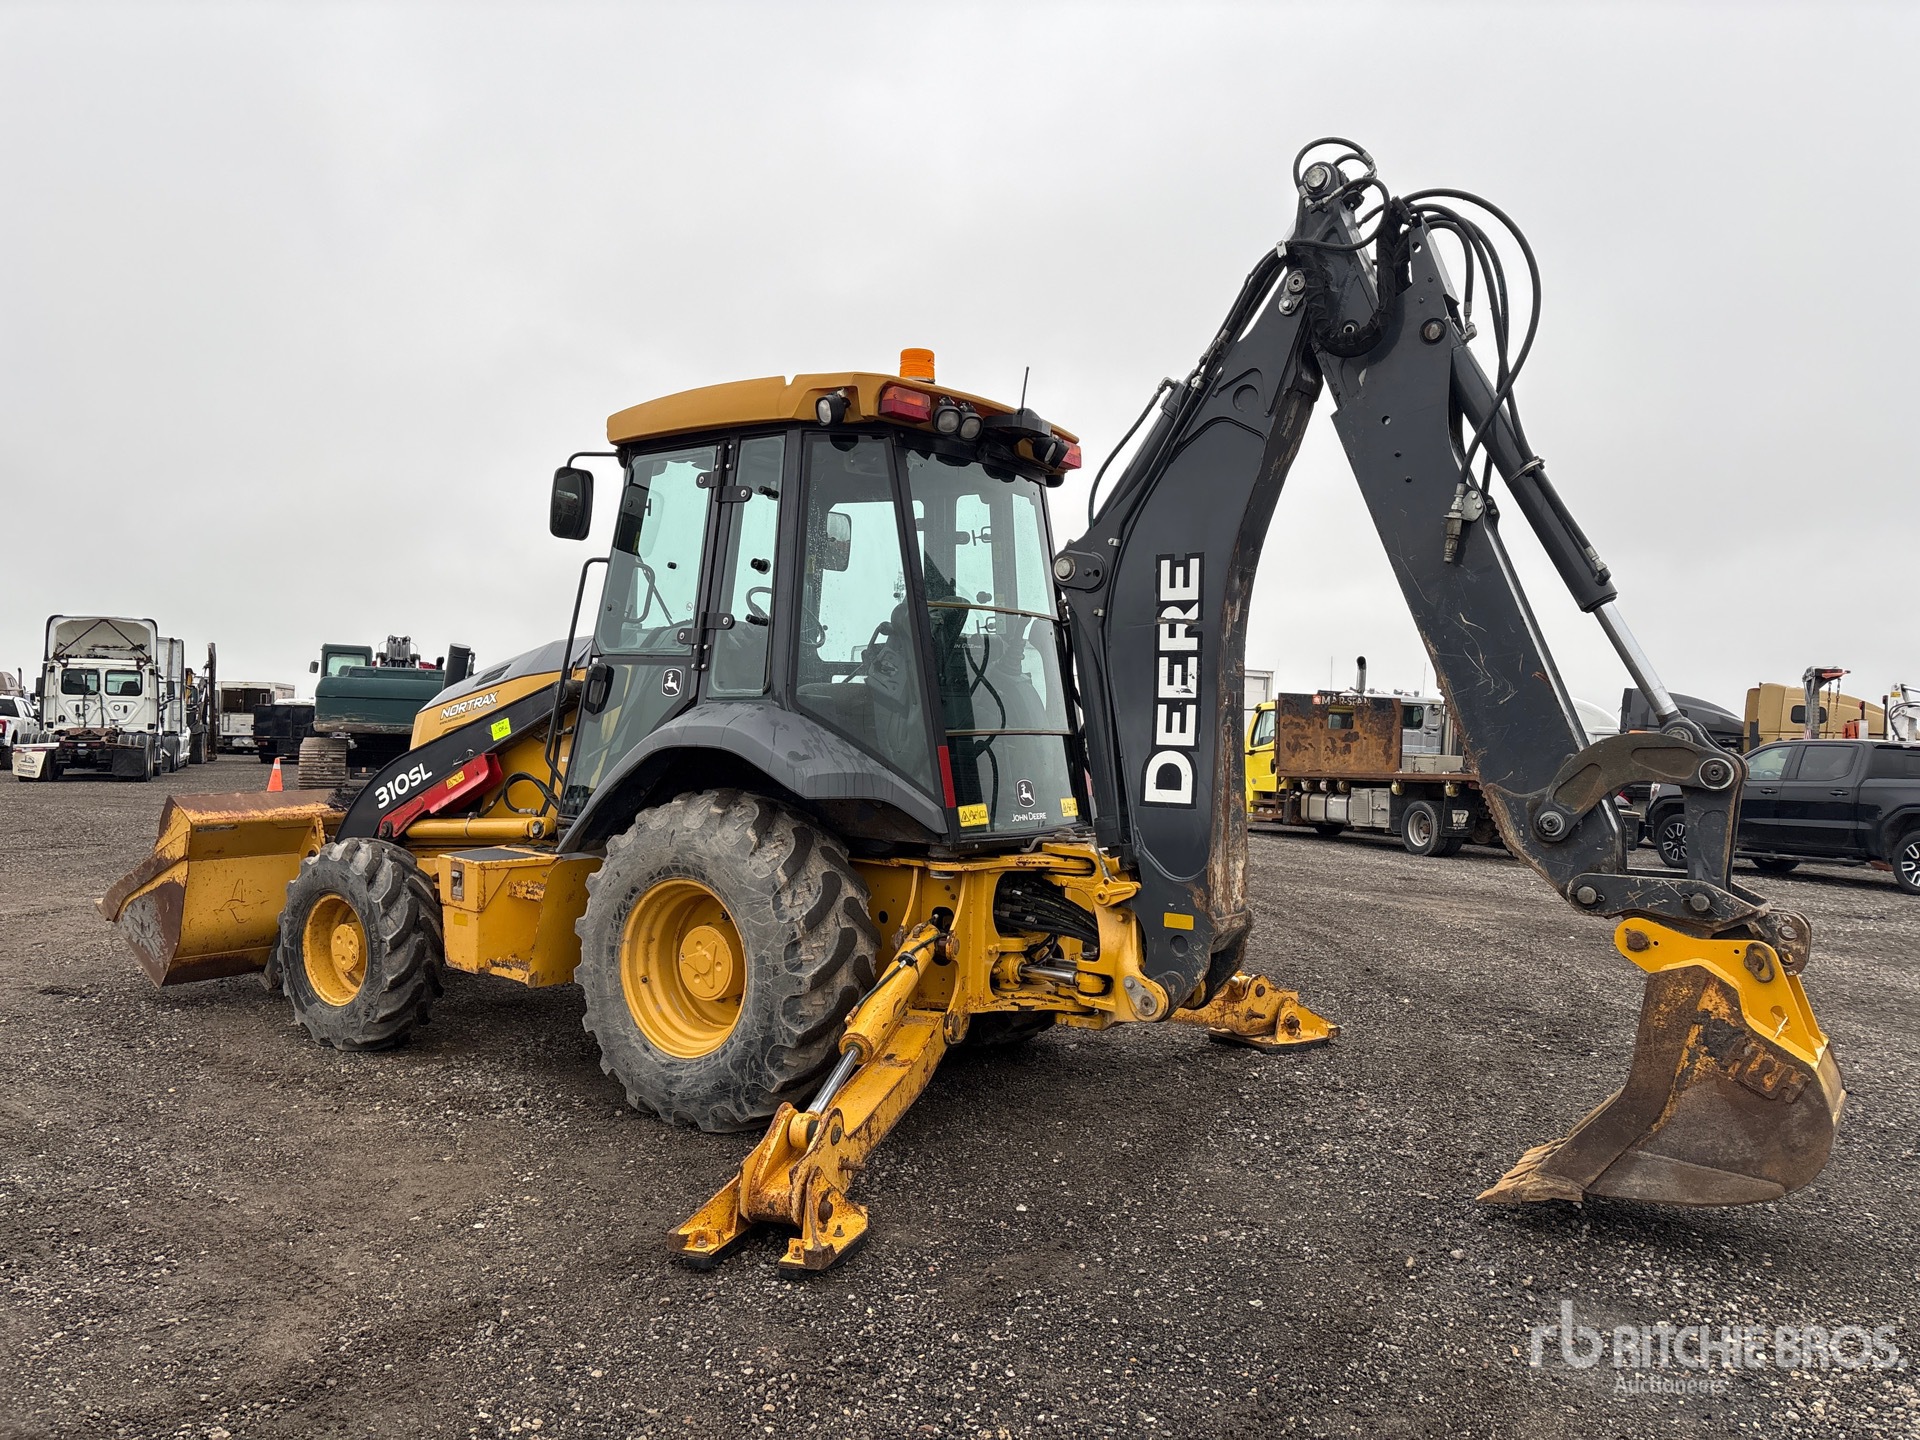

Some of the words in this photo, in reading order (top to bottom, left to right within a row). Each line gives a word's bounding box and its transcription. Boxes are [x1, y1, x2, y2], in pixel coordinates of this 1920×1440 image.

[1144, 558, 1200, 805] DEERE
[440, 690, 499, 720] NORTRAX
[375, 763, 433, 809] 310SL
[1011, 812, 1028, 822] JOHN
[1028, 811, 1047, 821] DEERE
